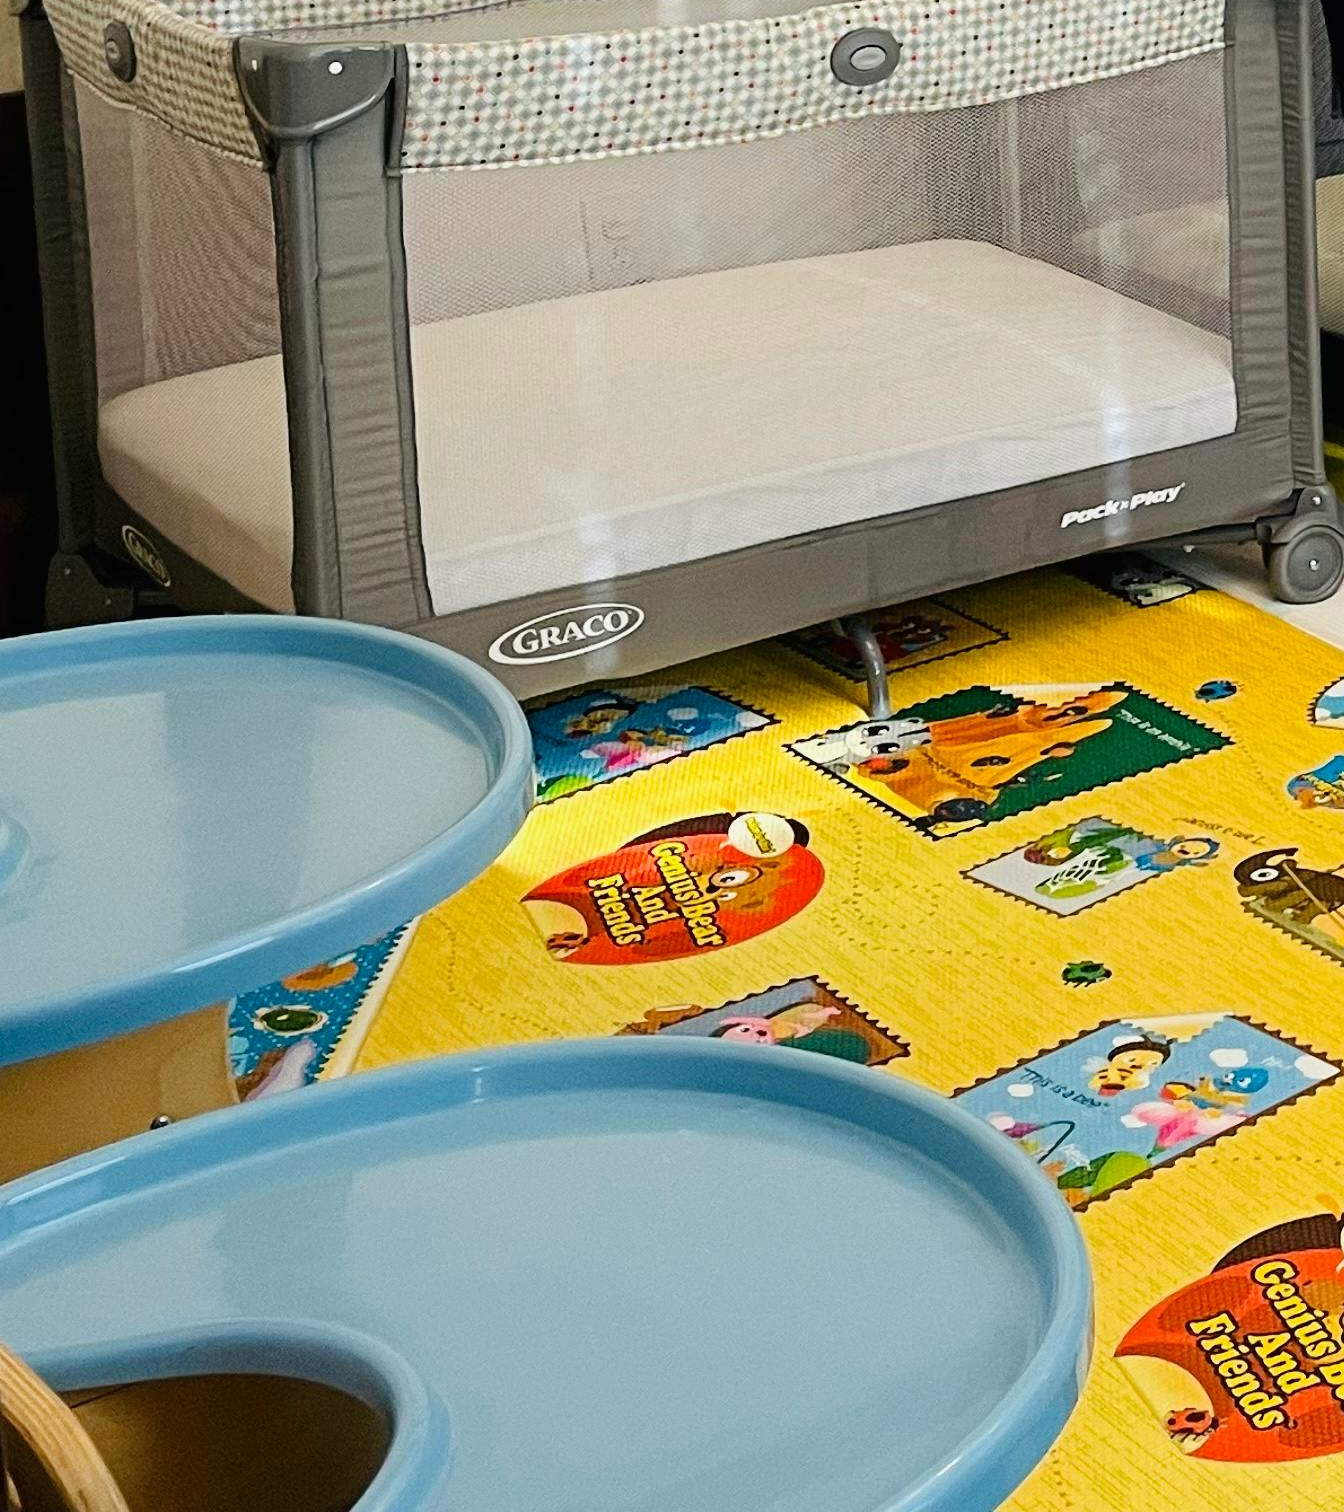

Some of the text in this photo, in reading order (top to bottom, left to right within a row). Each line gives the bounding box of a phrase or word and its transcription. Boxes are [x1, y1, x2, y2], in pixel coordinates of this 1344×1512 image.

[1060, 500, 1120, 528] Pack
[1129, 483, 1183, 510] Play
[512, 609, 632, 655] GRACO
[586, 872, 645, 947] Friends
[631, 885, 681, 926] And
[650, 841, 725, 947] Genius Bear
[1253, 1259, 1341, 1360] Genius
[1188, 1311, 1287, 1430] Friends
[1247, 1331, 1321, 1395] And
